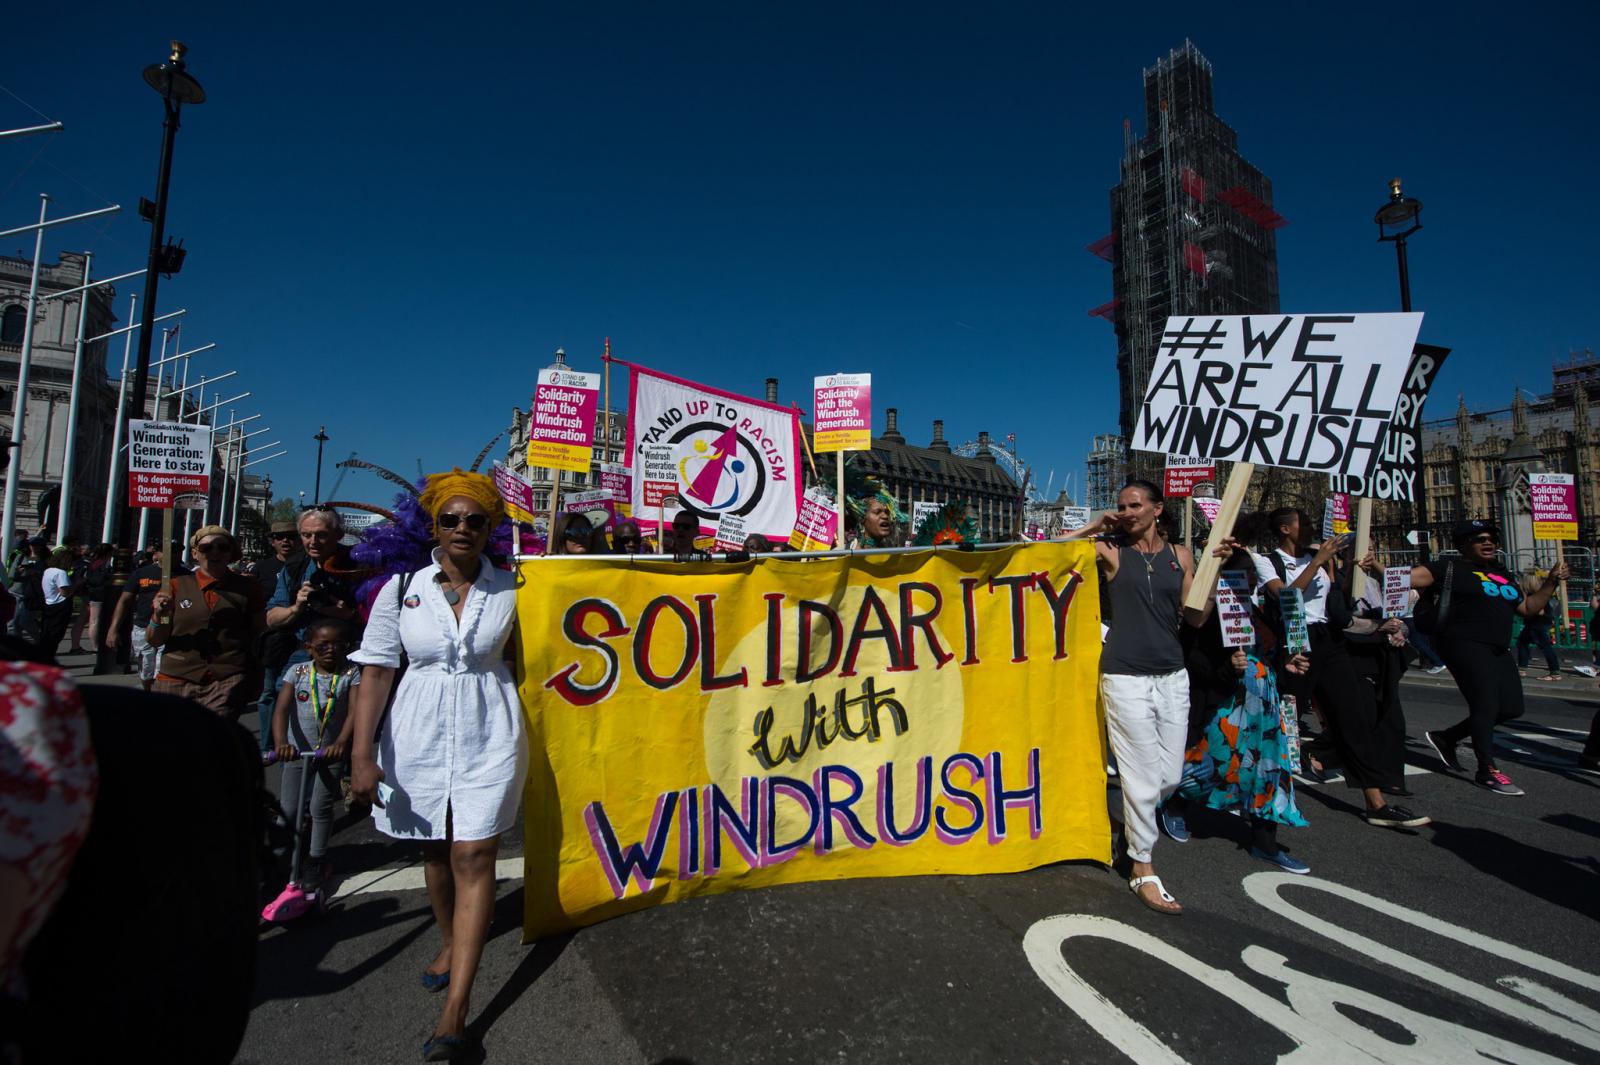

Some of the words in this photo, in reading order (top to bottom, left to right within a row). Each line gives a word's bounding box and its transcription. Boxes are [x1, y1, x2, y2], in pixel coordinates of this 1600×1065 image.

[817, 388, 860, 400] Solidarity
[1144, 359, 1273, 411] ARE
[1275, 362, 1392, 419] ALL
[538, 387, 586, 406] Solidarity
[537, 400, 557, 413] with
[560, 402, 577, 415] the
[817, 400, 836, 409] with
[838, 399, 853, 407] the
[817, 407, 859, 419] Windrush
[536, 412, 583, 429] Windrush
[816, 417, 864, 431] generation
[133, 430, 190, 445] Windrush
[533, 428, 587, 442] generation
[686, 400, 709, 416] UP
[716, 402, 737, 421] TO
[740, 418, 787, 482] RACISM
[1144, 402, 1390, 478] WINDRUSH
[133, 443, 204, 459] Generation:
[645, 451, 670, 460] Windrush
[133, 456, 161, 469] Here
[165, 458, 177, 470] to
[180, 460, 205, 474] stay
[645, 460, 677, 470] Generation:
[1168, 456, 1187, 465] Here
[1189, 456, 1197, 464] to
[137, 474, 149, 483] No
[151, 475, 200, 486] deportations
[645, 470, 657, 479] Here
[659, 470, 665, 479] to
[666, 471, 677, 481] stay
[1178, 470, 1209, 478] deportations
[138, 484, 158, 495] Open
[160, 486, 172, 495] the
[1532, 485, 1567, 496] Solidarity
[138, 494, 168, 503] borders
[1533, 495, 1550, 503] with
[1552, 495, 1563, 503] the
[569, 502, 605, 512] Solidarity
[803, 500, 832, 520] Solidarity
[1534, 502, 1568, 511] Windrush
[801, 508, 813, 520] with
[1534, 511, 1572, 521] generation
[720, 519, 743, 529] Windrush
[717, 531, 728, 540] Here
[545, 570, 1084, 706] SOLIDARITY
[584, 747, 1042, 899] WINDRUSH
